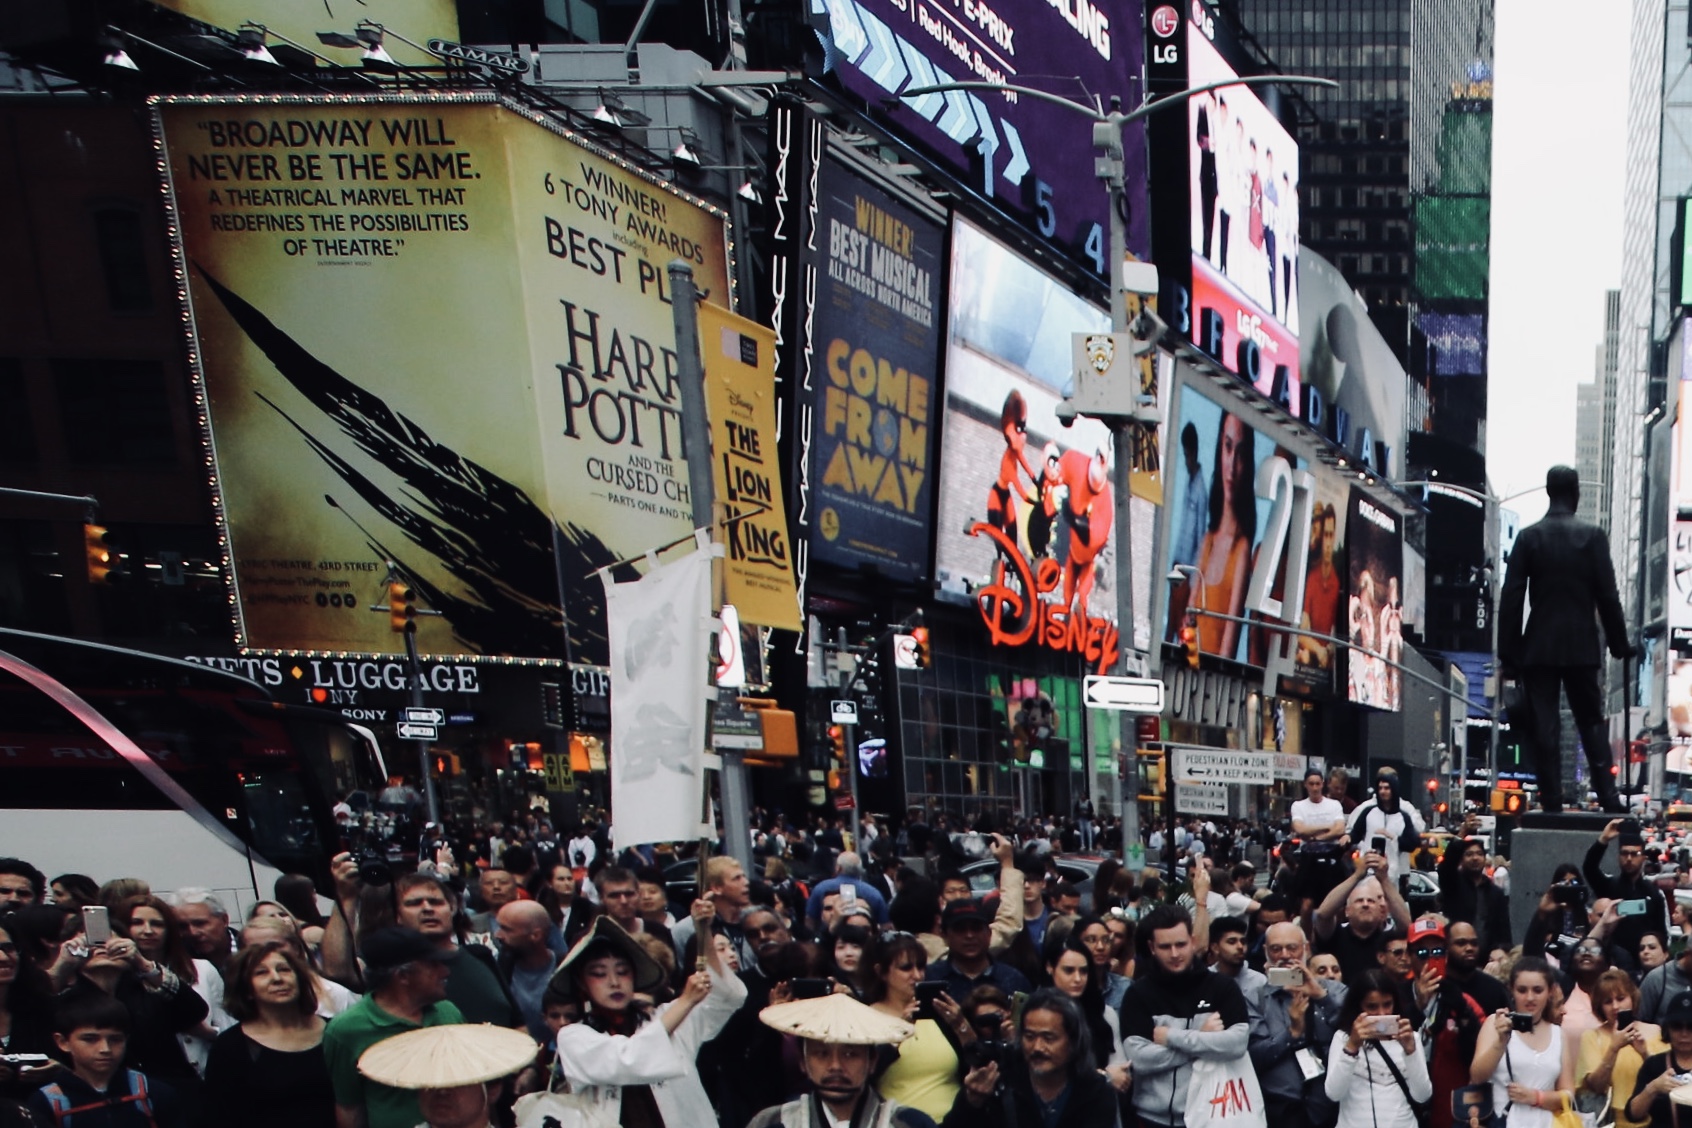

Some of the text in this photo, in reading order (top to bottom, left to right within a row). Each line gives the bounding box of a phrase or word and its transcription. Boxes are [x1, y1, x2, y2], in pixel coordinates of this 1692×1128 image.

[437, 41, 519, 72] LAMAR
[918, 4, 1019, 105] Red Hook, Brookyn
[1153, 44, 1178, 64] LG
[382, 118, 457, 148] WILL
[188, 153, 481, 181] NEVER BE THE SAME.
[208, 188, 467, 206] A THEATRICAL MARVEL THAT
[580, 162, 668, 224] WINNER!
[211, 213, 470, 232] REDEFINES THE POSSIBILITIES
[544, 172, 705, 265] 6 TONY AWARDS
[855, 194, 915, 261] WINNER!
[284, 239, 308, 256] OF
[545, 215, 626, 284] BEST
[613, 231, 649, 257] including
[829, 217, 932, 310] BEST MUSICAL
[828, 258, 844, 282] ALL
[845, 267, 876, 299] ACROSS
[877, 283, 901, 312] NORTH
[902, 298, 932, 329] AMERICA
[826, 337, 929, 423] COME
[555, 363, 689, 462] POTT
[724, 420, 761, 456] THE
[586, 457, 659, 496] CURSED
[628, 454, 676, 478] AND THE
[723, 453, 772, 502] LION
[822, 441, 926, 514] AWAY
[608, 492, 695, 522] PARTS ONE AND TW
[726, 503, 786, 561] KING
[318, 561, 342, 571] 43RD
[344, 562, 379, 572] STREET
[305, 688, 358, 705] I NY
[341, 707, 387, 721] SONY
[1185, 754, 1229, 766] PEDESTRIAN
[1229, 755, 1249, 767] FLOW
[1250, 756, 1270, 768] ZONE
[1223, 768, 1241, 778] KEEP
[1242, 768, 1270, 780] MOVING
